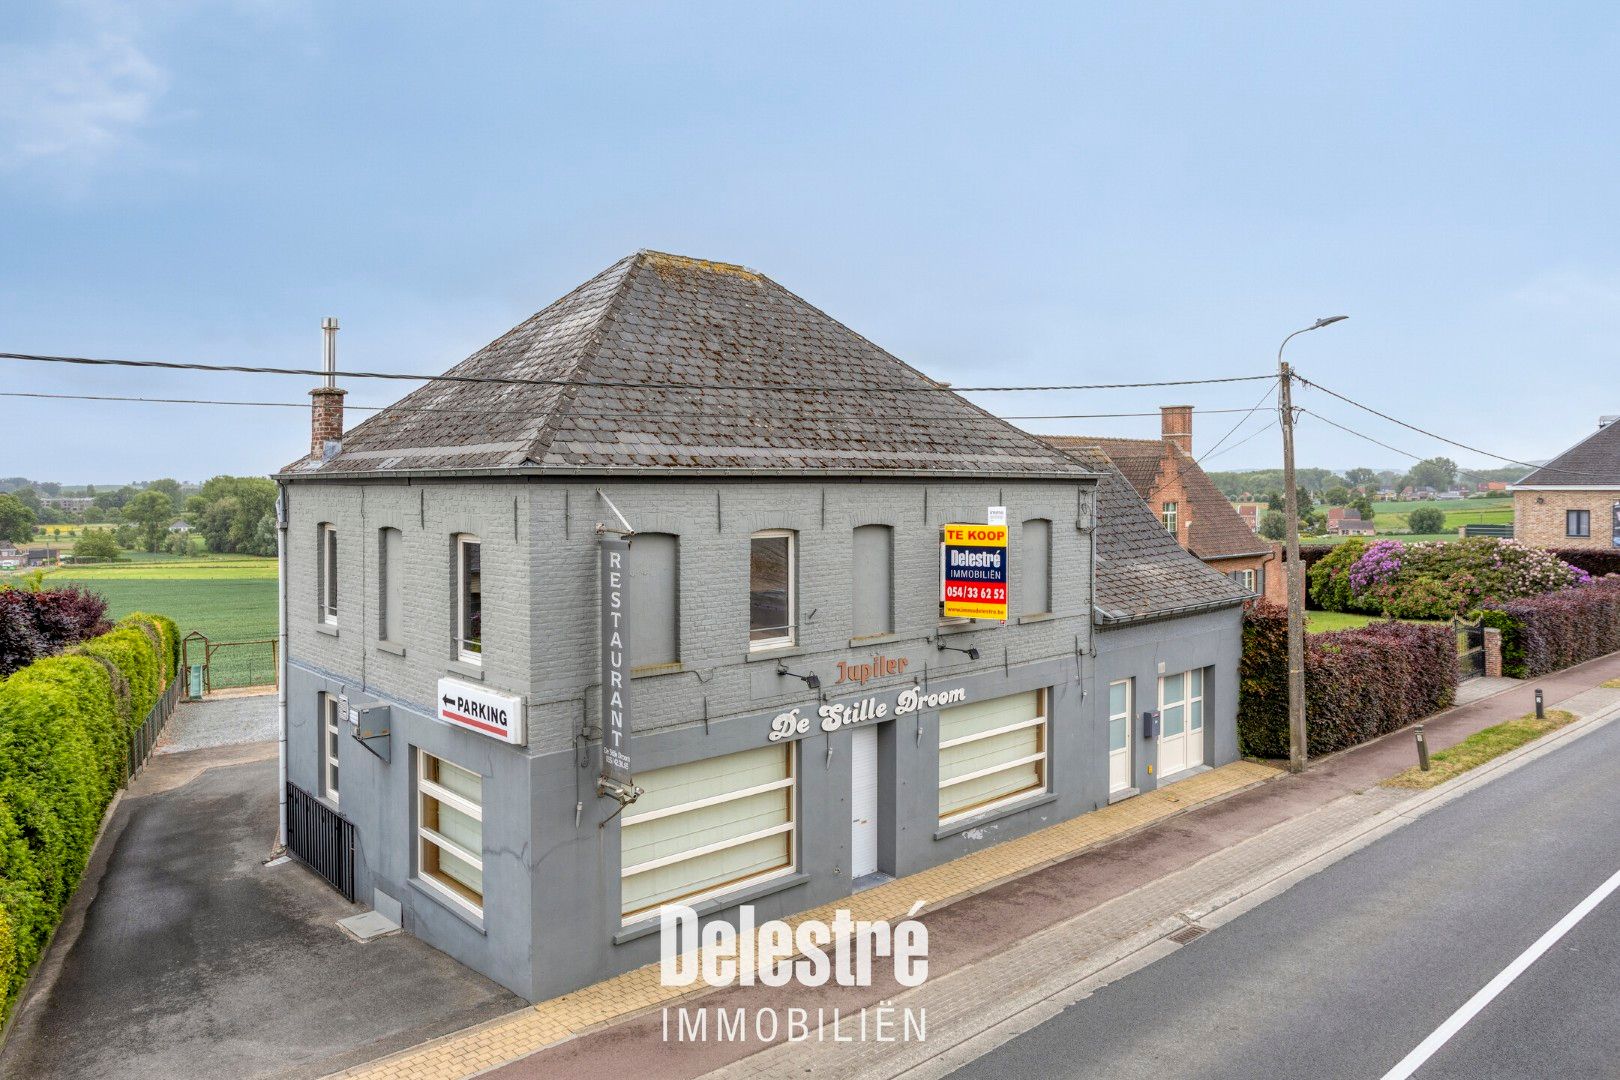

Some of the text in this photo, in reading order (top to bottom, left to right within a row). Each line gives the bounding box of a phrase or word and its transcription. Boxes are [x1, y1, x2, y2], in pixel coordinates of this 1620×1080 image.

[947, 530, 1005, 541] TE KOOP
[950, 549, 1001, 568] Delestré
[950, 569, 1001, 580] IMMOBILIËN
[947, 585, 1005, 600] 054/33 62 52
[609, 551, 623, 747] RESTAURANT
[835, 655, 909, 685] Jupiler
[457, 696, 508, 727] PARKING
[768, 686, 966, 741] De Stille Droom
